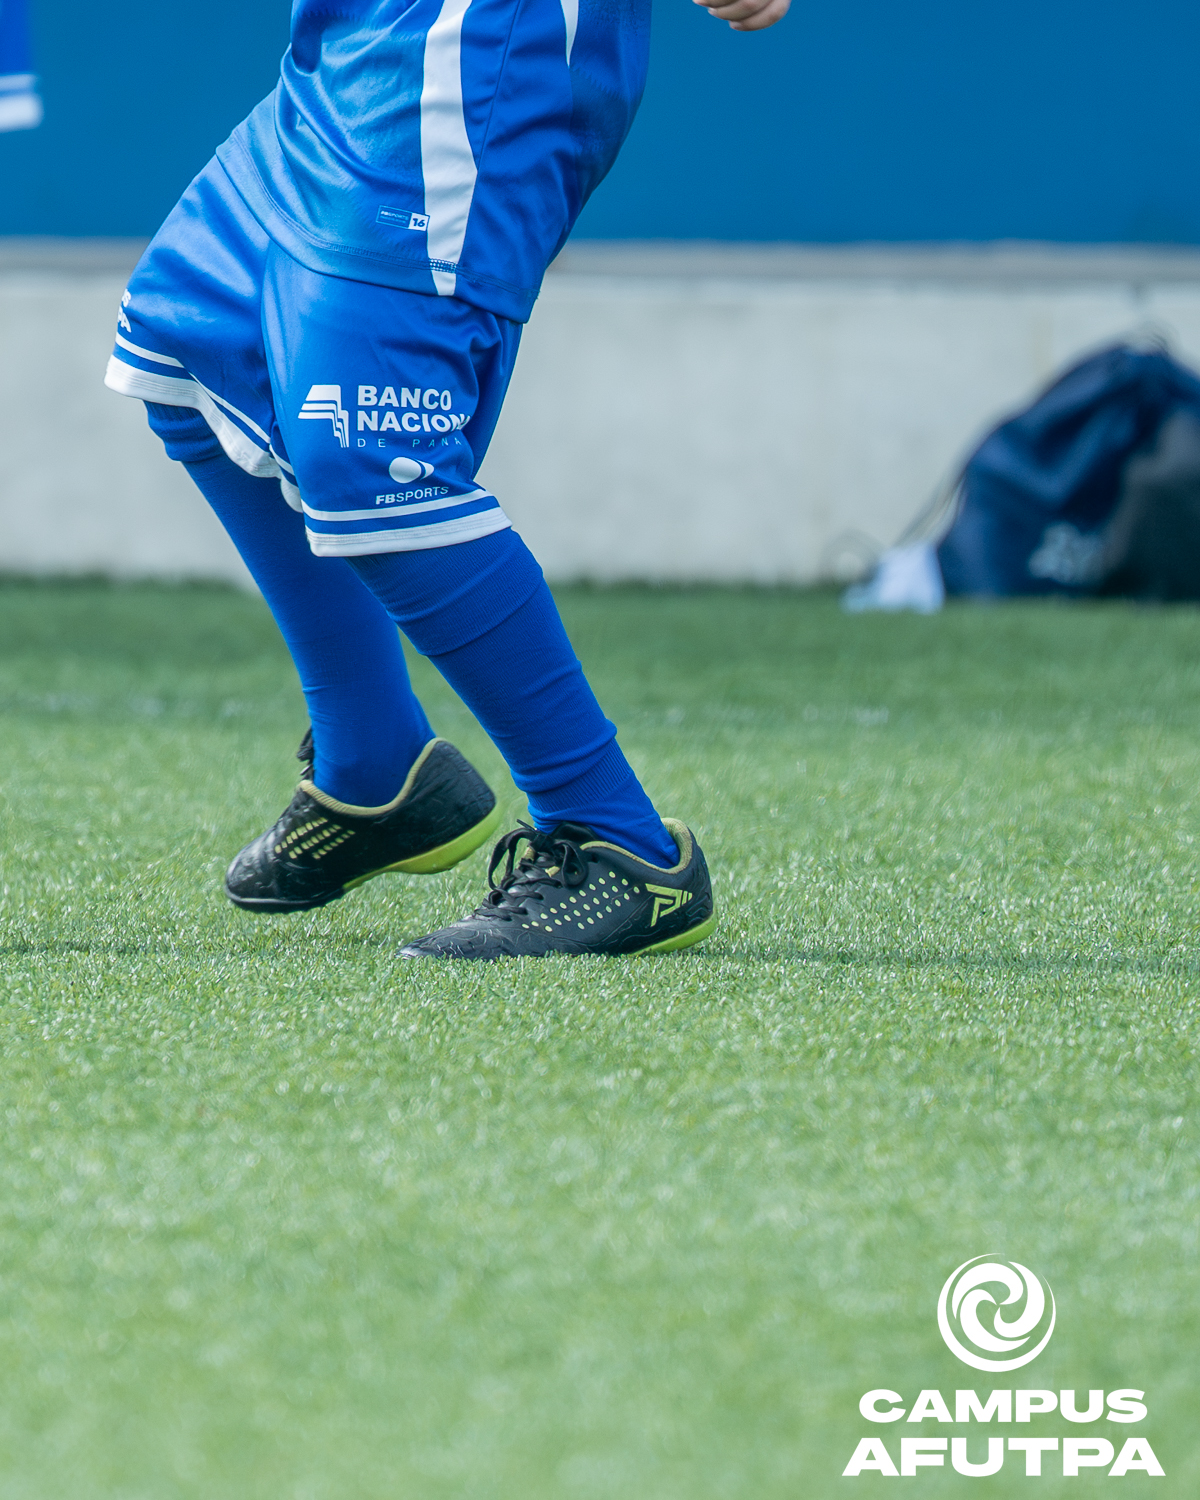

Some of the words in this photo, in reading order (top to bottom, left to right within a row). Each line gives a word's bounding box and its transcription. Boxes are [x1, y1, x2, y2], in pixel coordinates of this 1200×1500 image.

[357, 385, 452, 411] BANCO
[357, 438, 387, 448] DE
[375, 486, 449, 505] FBSPORTS
